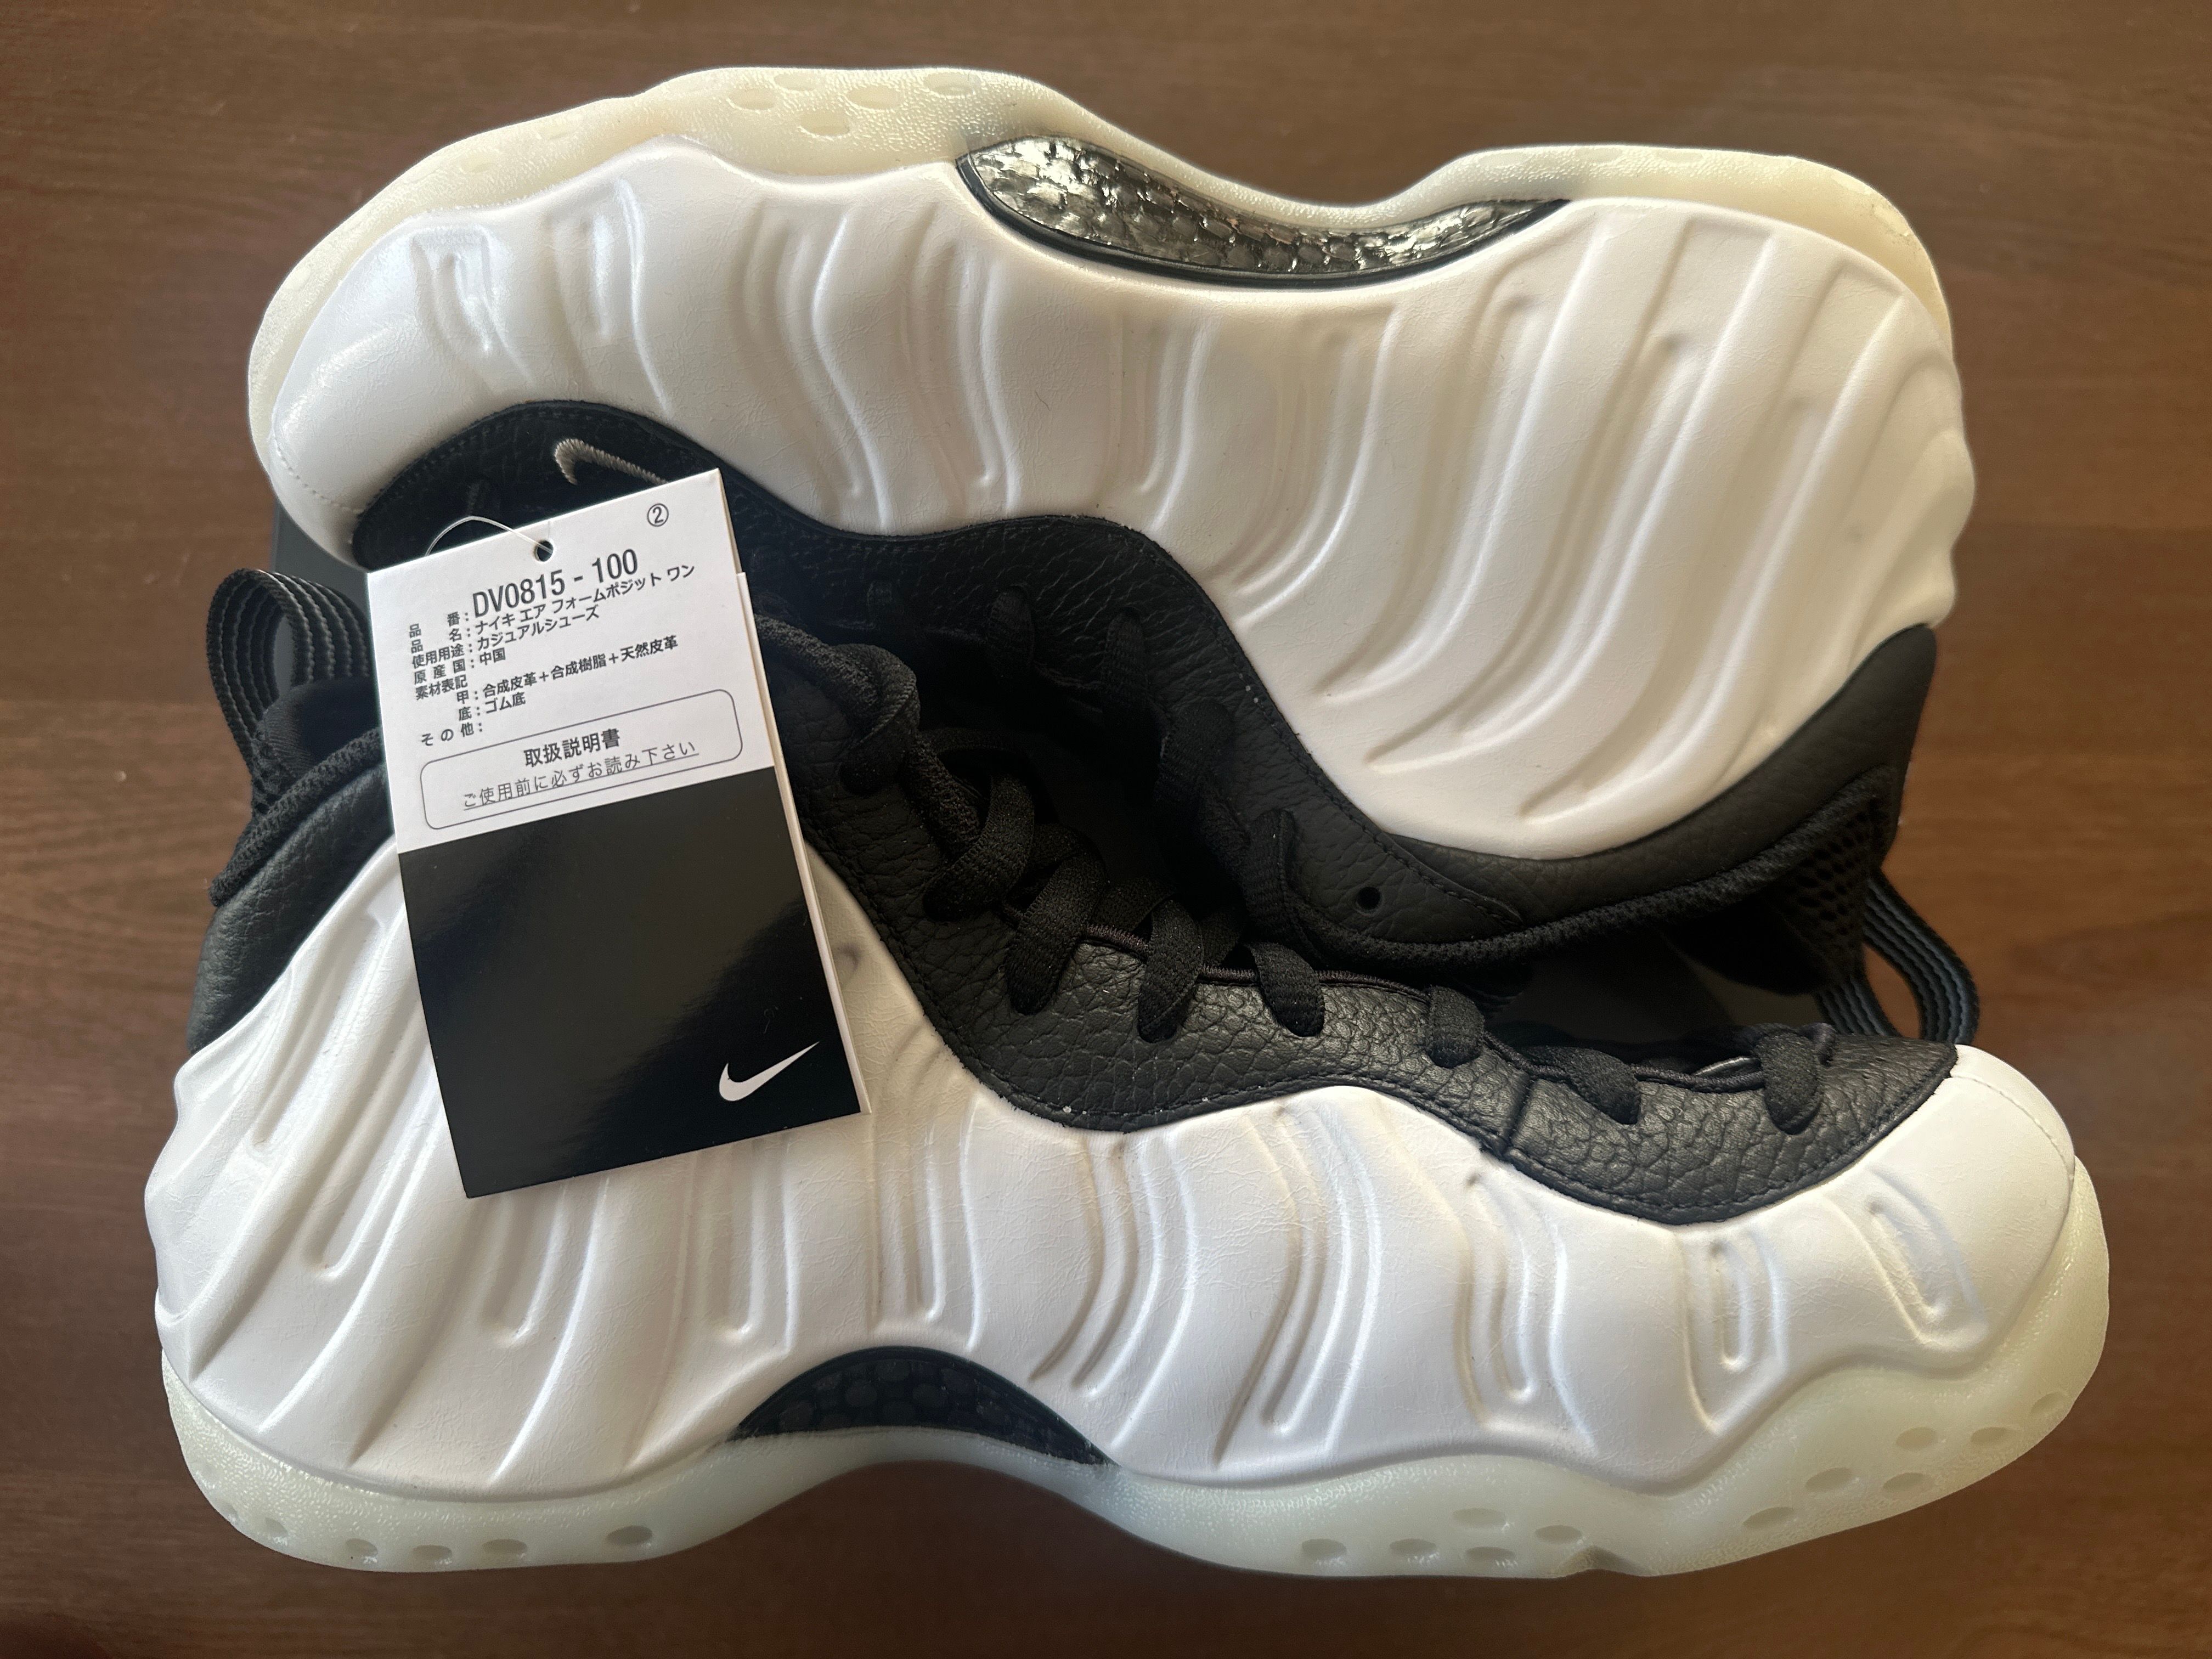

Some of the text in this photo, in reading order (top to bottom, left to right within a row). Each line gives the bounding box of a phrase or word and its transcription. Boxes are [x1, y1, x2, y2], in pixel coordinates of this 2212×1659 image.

[472, 569, 566, 618] DV0815
[592, 549, 638, 583] 100
[475, 613, 515, 635] ナイキ
[520, 604, 546, 622] エア
[552, 573, 662, 614] フォームポジット
[667, 565, 695, 582] ワン
[479, 647, 506, 665] 中国
[415, 674, 468, 701] 素材表記
[485, 692, 526, 714] ゴム底
[523, 728, 620, 768] 取扱説明書
[463, 741, 696, 808] ご使用前に必ずお読み下さい
